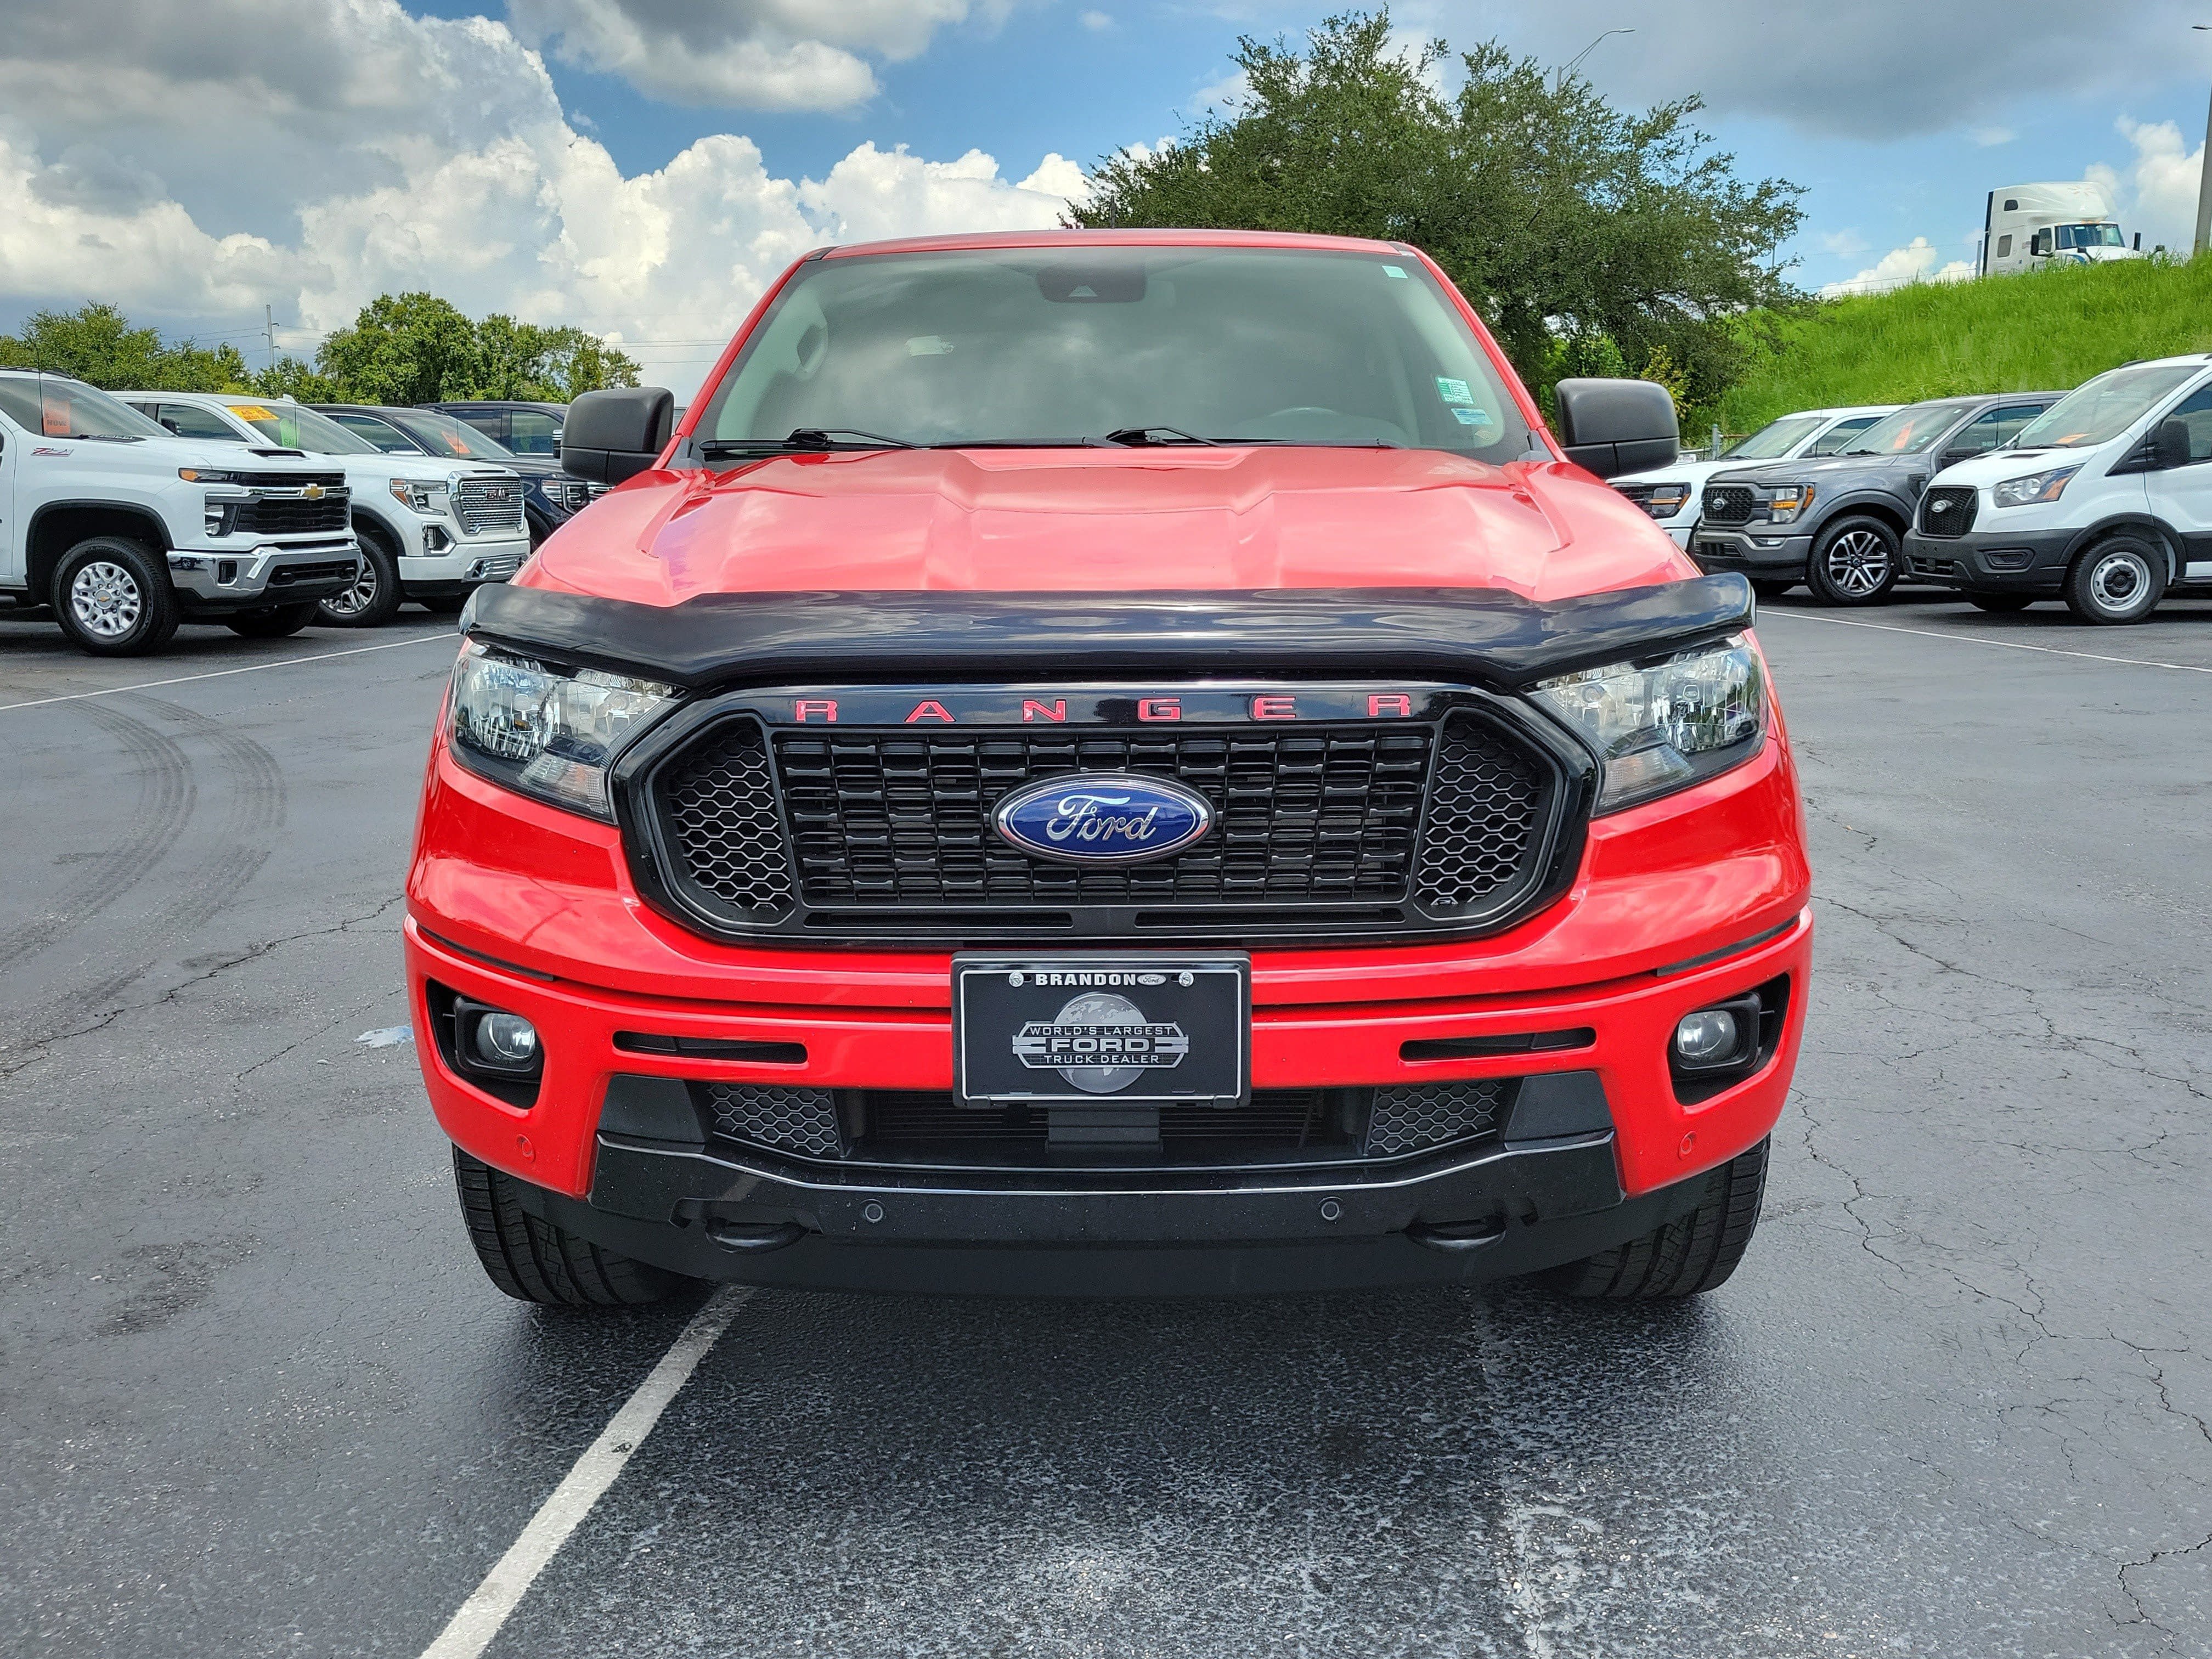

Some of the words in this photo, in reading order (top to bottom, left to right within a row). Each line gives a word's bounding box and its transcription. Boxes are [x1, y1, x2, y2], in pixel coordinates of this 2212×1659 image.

[284, 438, 297, 447] SAL
[794, 694, 1412, 723] RANGER
[1046, 794, 1159, 842] Ford
[1035, 974, 1136, 986] BRANDON
[1030, 1026, 1097, 1035] WORLD'S
[1104, 1026, 1173, 1035] LARGEST
[1051, 1038, 1150, 1052] FORD
[1043, 1055, 1094, 1064] TRUCK
[1101, 1055, 1159, 1064] DEALER
